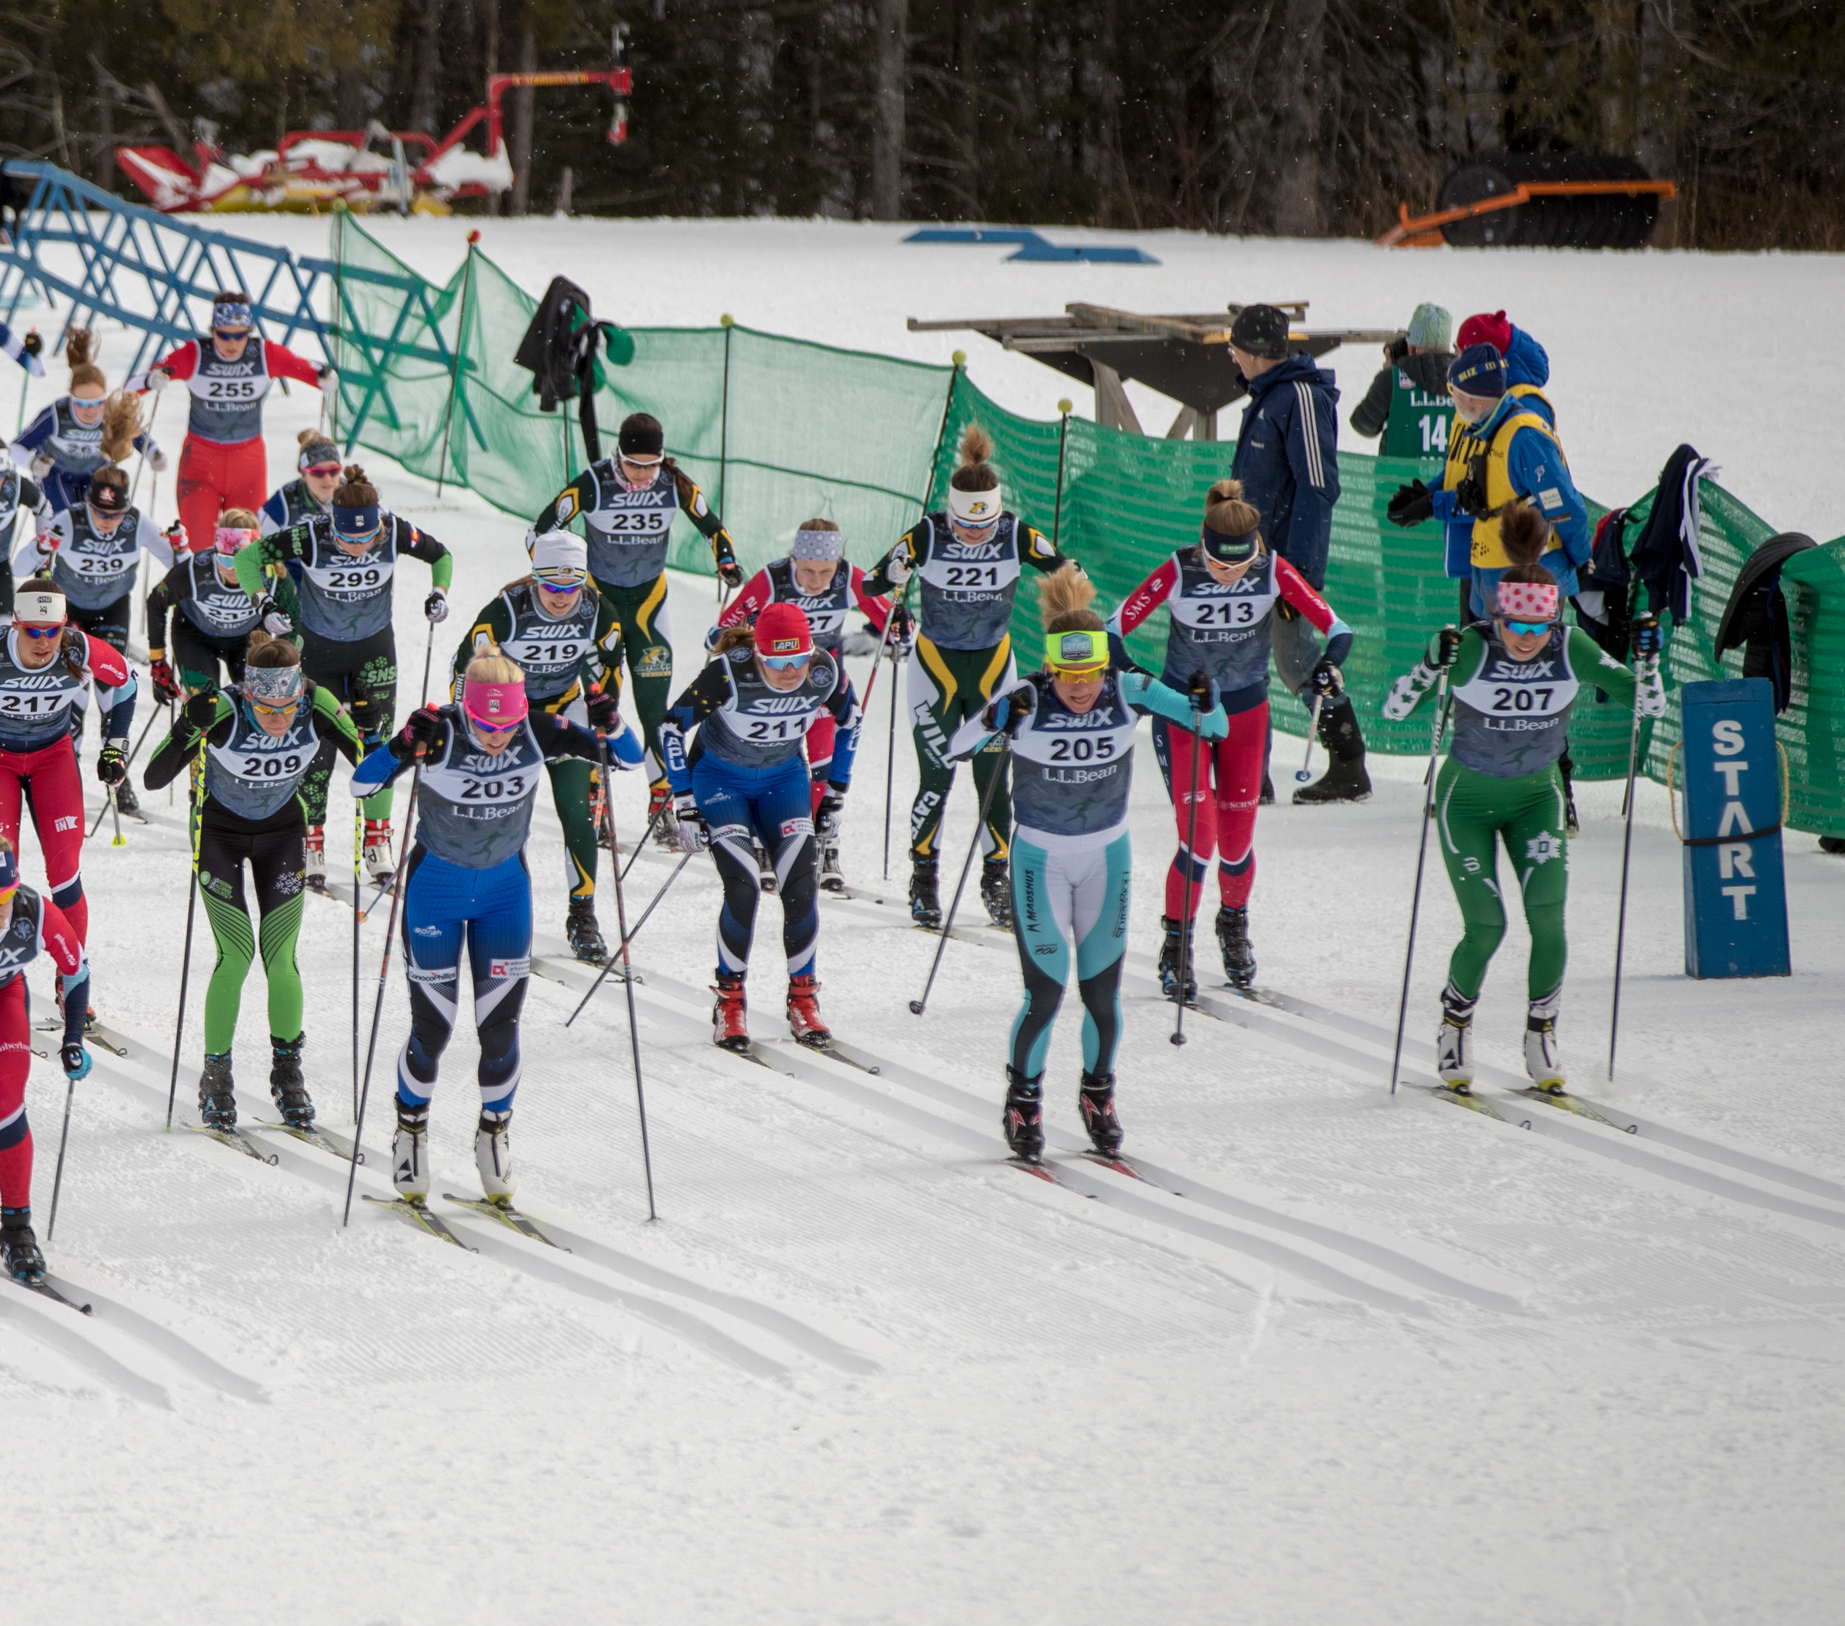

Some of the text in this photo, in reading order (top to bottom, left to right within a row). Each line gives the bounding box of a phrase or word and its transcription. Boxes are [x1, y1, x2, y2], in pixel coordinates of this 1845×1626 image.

[207, 362, 254, 376] SWIX
[1457, 366, 1478, 383] BLIZ
[208, 382, 255, 398] 255
[1410, 390, 1454, 407] L.L.Be
[608, 490, 668, 508] SWIX
[611, 512, 664, 531] 235
[605, 534, 666, 546] L.L.Bean
[942, 542, 1004, 560] SWIX
[80, 557, 124, 572] 239
[328, 570, 380, 588] 299
[945, 566, 999, 587] 221
[941, 589, 1003, 603] L.L.Bean
[1191, 577, 1261, 596] SWIX
[1124, 592, 1152, 621] SMS
[1194, 602, 1256, 625] 213
[719, 606, 746, 630] SMS
[525, 622, 584, 639] SWIX
[1189, 629, 1257, 644] L.L.Bean
[523, 644, 579, 661] 219
[776, 639, 798, 650] APU
[366, 670, 399, 686] SNS
[1488, 660, 1556, 679] SWIX
[4, 673, 70, 691] SWIX
[0, 695, 64, 714] 217
[745, 695, 822, 714] SWIX
[1492, 687, 1554, 712] 207
[1044, 705, 1116, 730] SWIX
[1482, 717, 1560, 733] L.L.Bean
[745, 718, 808, 740] 211
[666, 735, 687, 771] APU
[1048, 734, 1117, 762] 205
[242, 755, 303, 778] 209
[459, 746, 524, 773] SWIX
[1042, 763, 1118, 784] L.L.Bean
[460, 776, 526, 799] 203
[452, 801, 526, 821] L.L.Bean
[1711, 719, 1757, 921] START
[1026, 867, 1036, 923] MADSHUS
